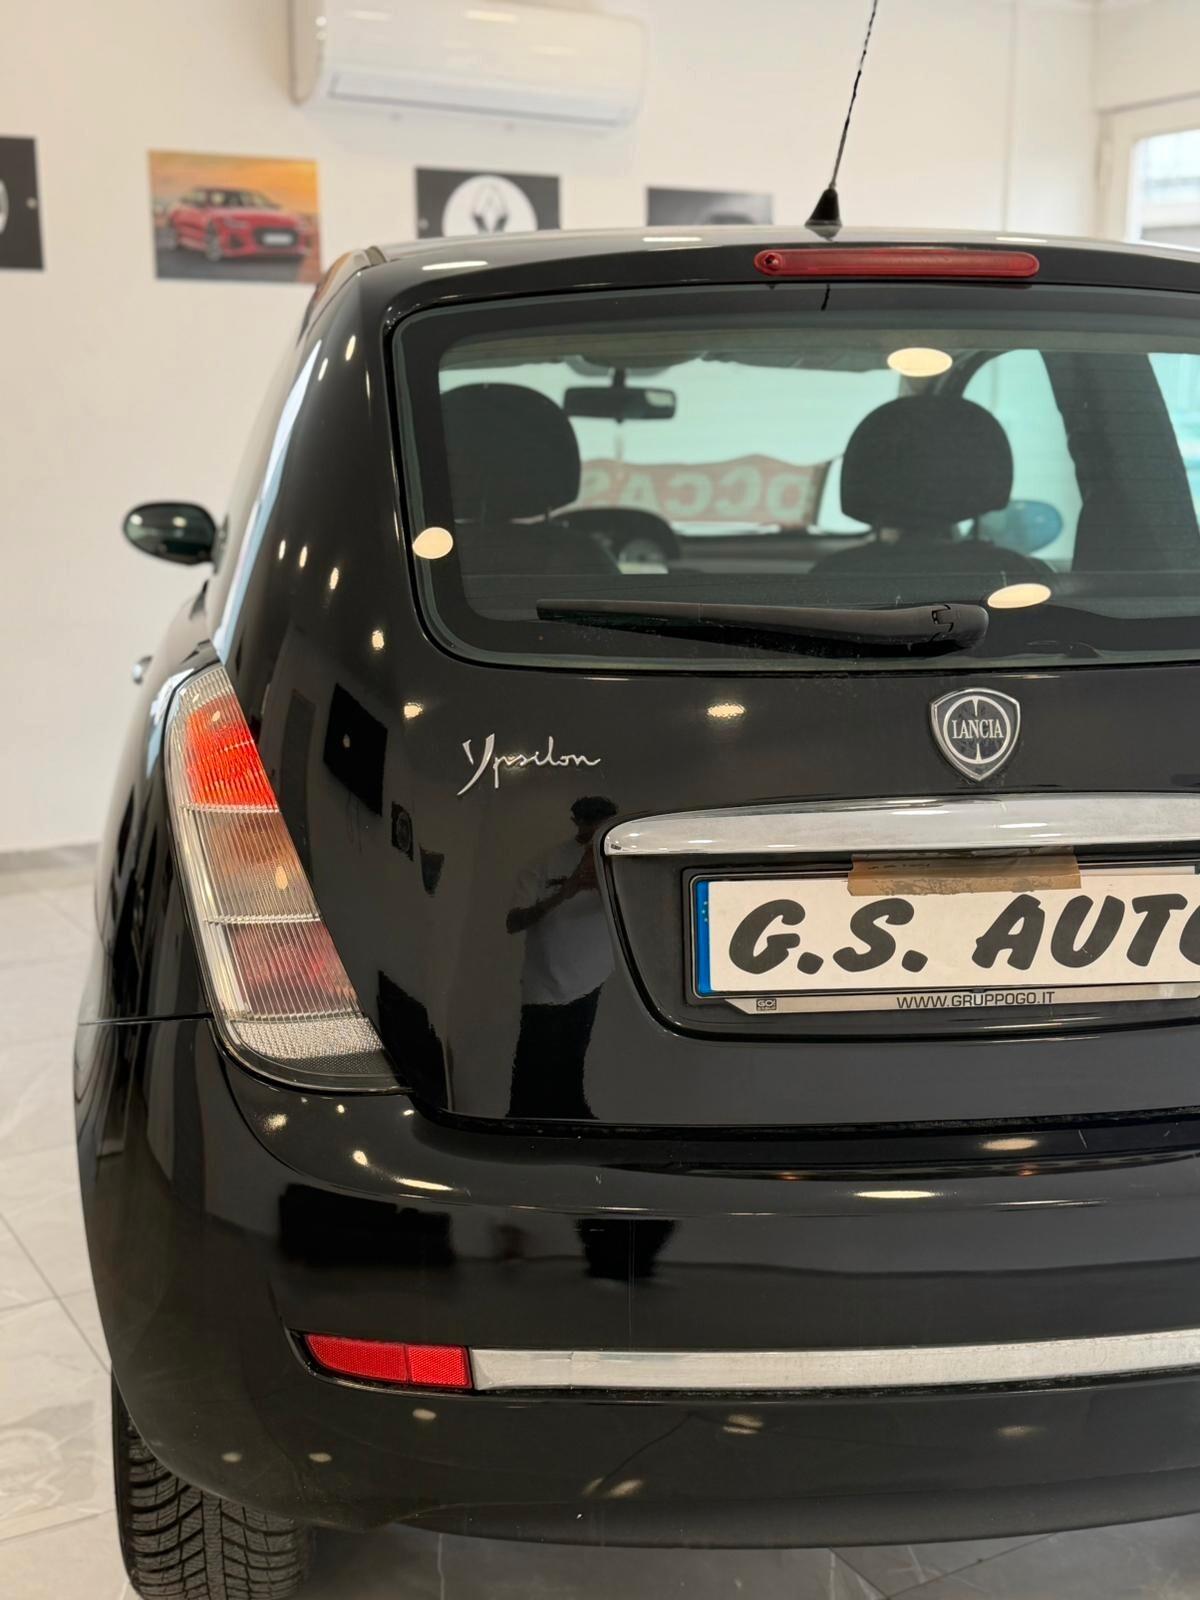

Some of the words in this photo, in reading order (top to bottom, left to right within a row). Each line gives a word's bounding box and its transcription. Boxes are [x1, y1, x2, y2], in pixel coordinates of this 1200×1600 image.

[952, 719, 1004, 739] LANCIA
[457, 733, 601, 795] Ypsilon
[729, 898, 928, 975] G.S.
[897, 992, 1055, 1008] WWW.GRUPPOGO.IT
